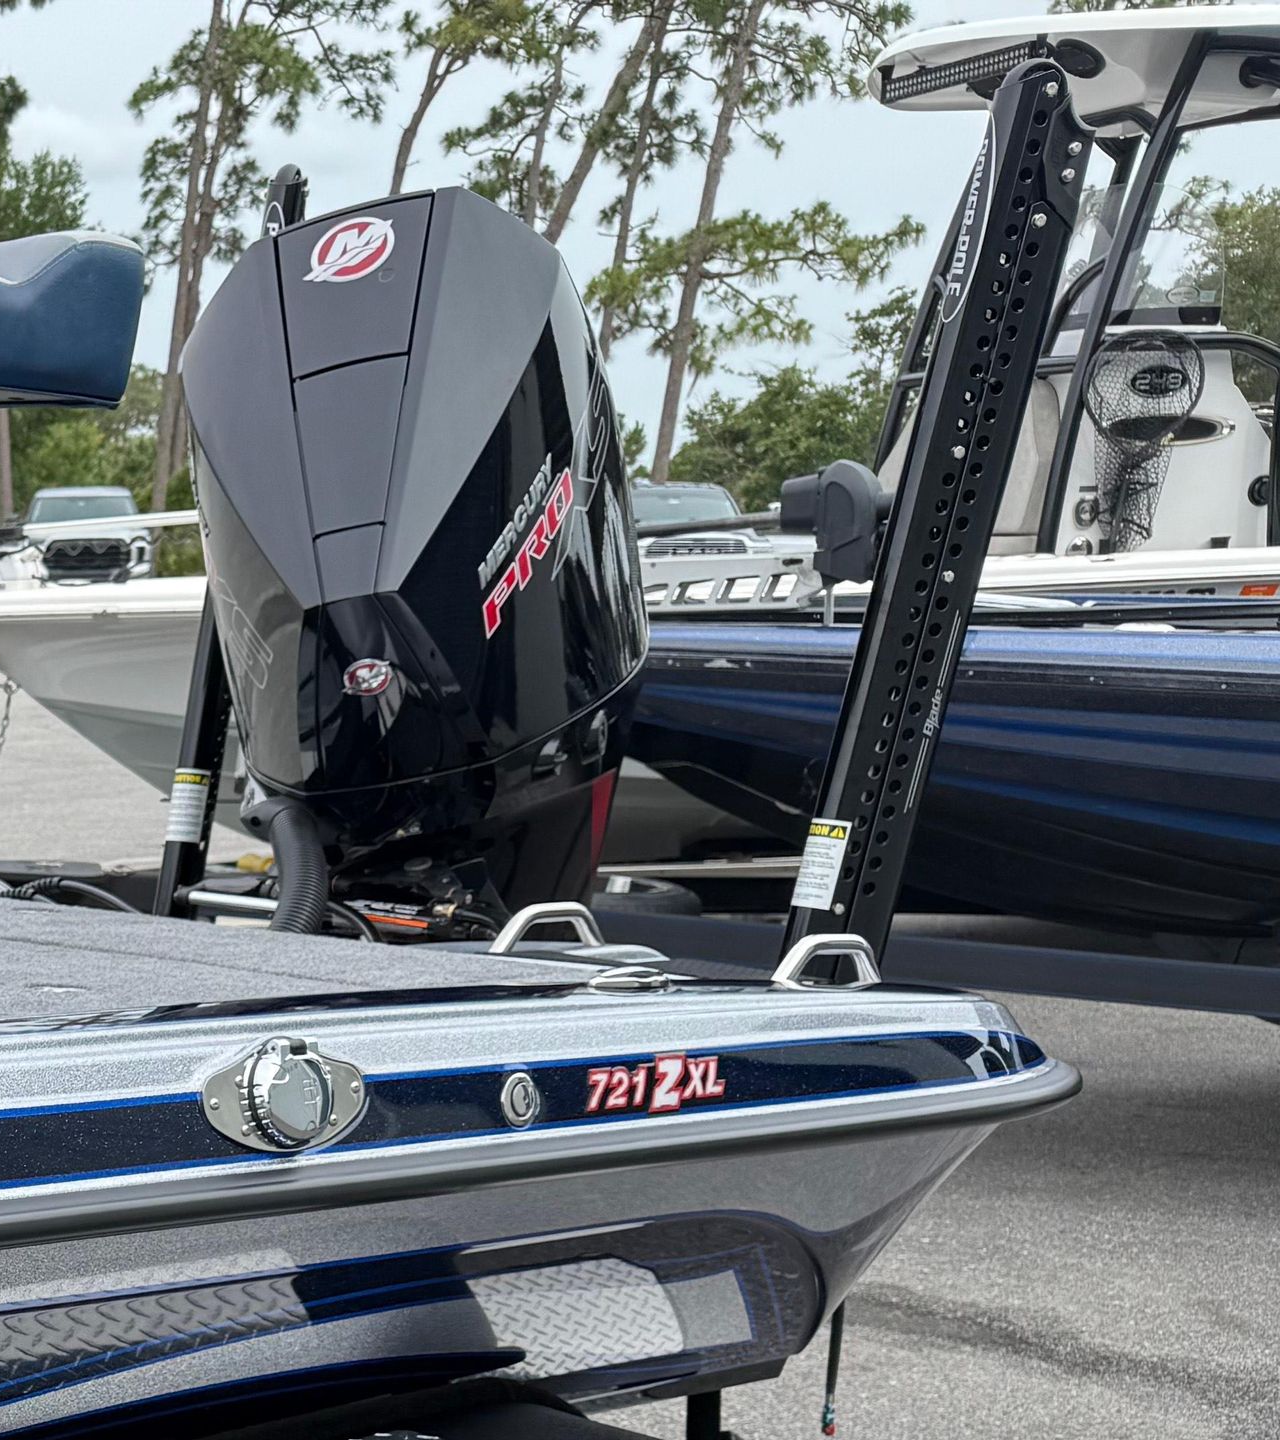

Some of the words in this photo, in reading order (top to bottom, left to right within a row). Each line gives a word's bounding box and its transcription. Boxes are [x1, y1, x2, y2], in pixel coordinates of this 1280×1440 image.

[477, 452, 552, 591] MERCURY
[482, 466, 574, 640] PRO
[922, 688, 944, 737] Blade
